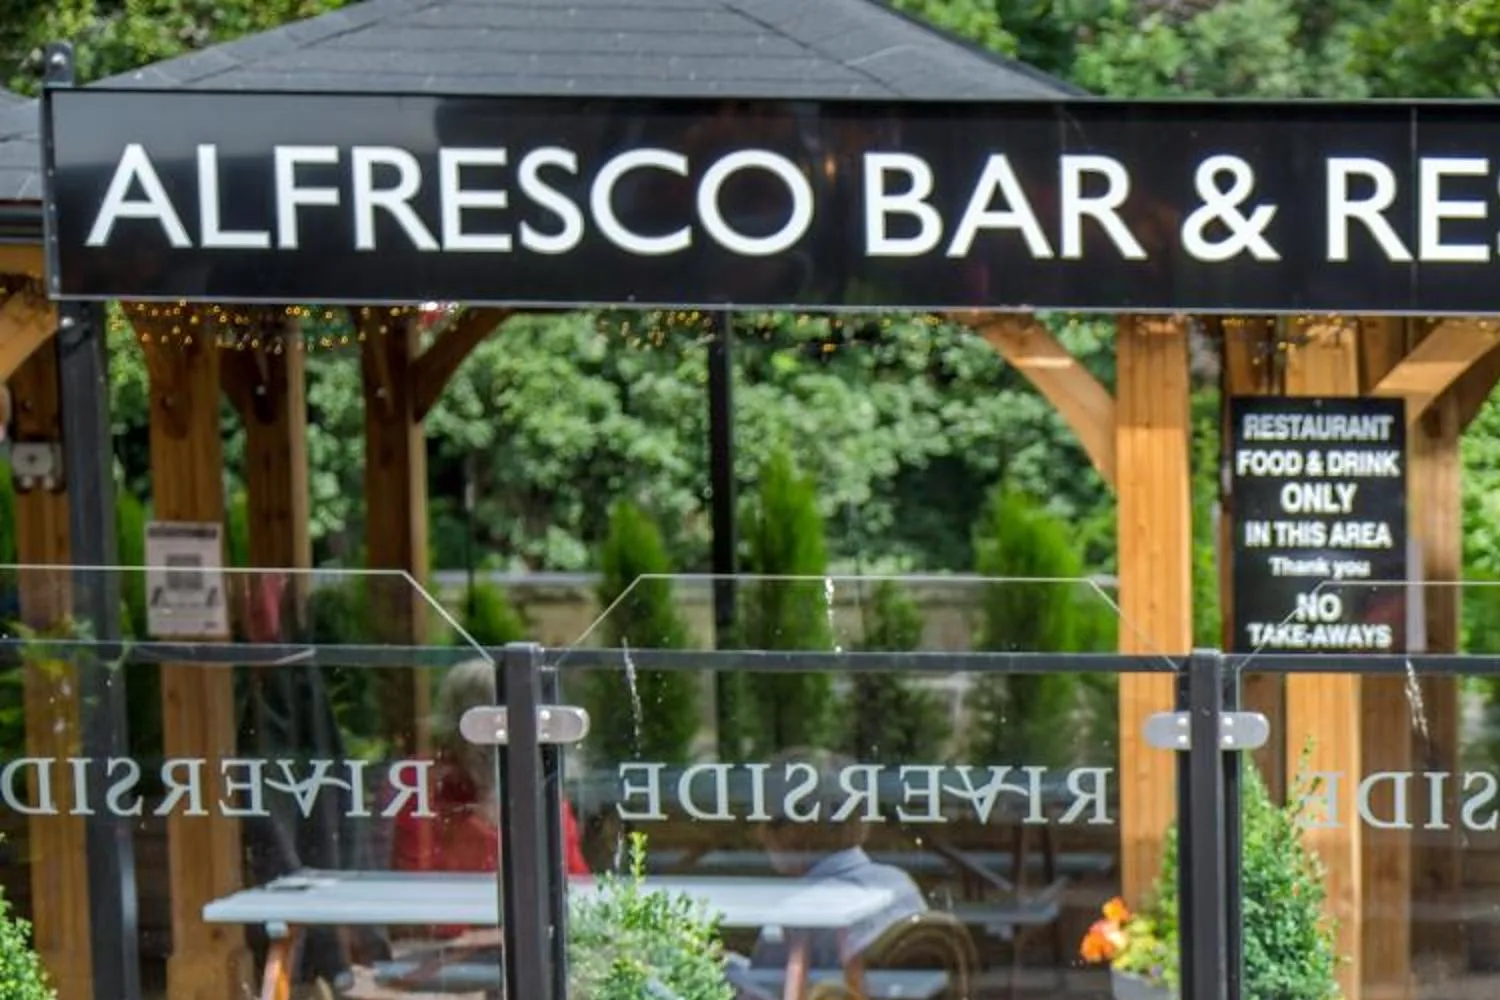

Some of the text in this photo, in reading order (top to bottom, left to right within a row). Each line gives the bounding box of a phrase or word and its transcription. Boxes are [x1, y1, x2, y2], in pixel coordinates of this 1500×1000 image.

[86, 144, 815, 256] ALFRESCO
[863, 152, 1148, 260] BAR
[1180, 154, 1282, 263] &
[1242, 413, 1394, 440] RESTAURANT
[1236, 450, 1401, 477] FOOD & DRINK
[1280, 482, 1358, 513] ONLY
[1244, 521, 1393, 548] IN THIS AREA
[1269, 556, 1371, 580] Thank you
[1295, 592, 1343, 621] NO
[1246, 623, 1393, 648] TAKE-AWAYS
